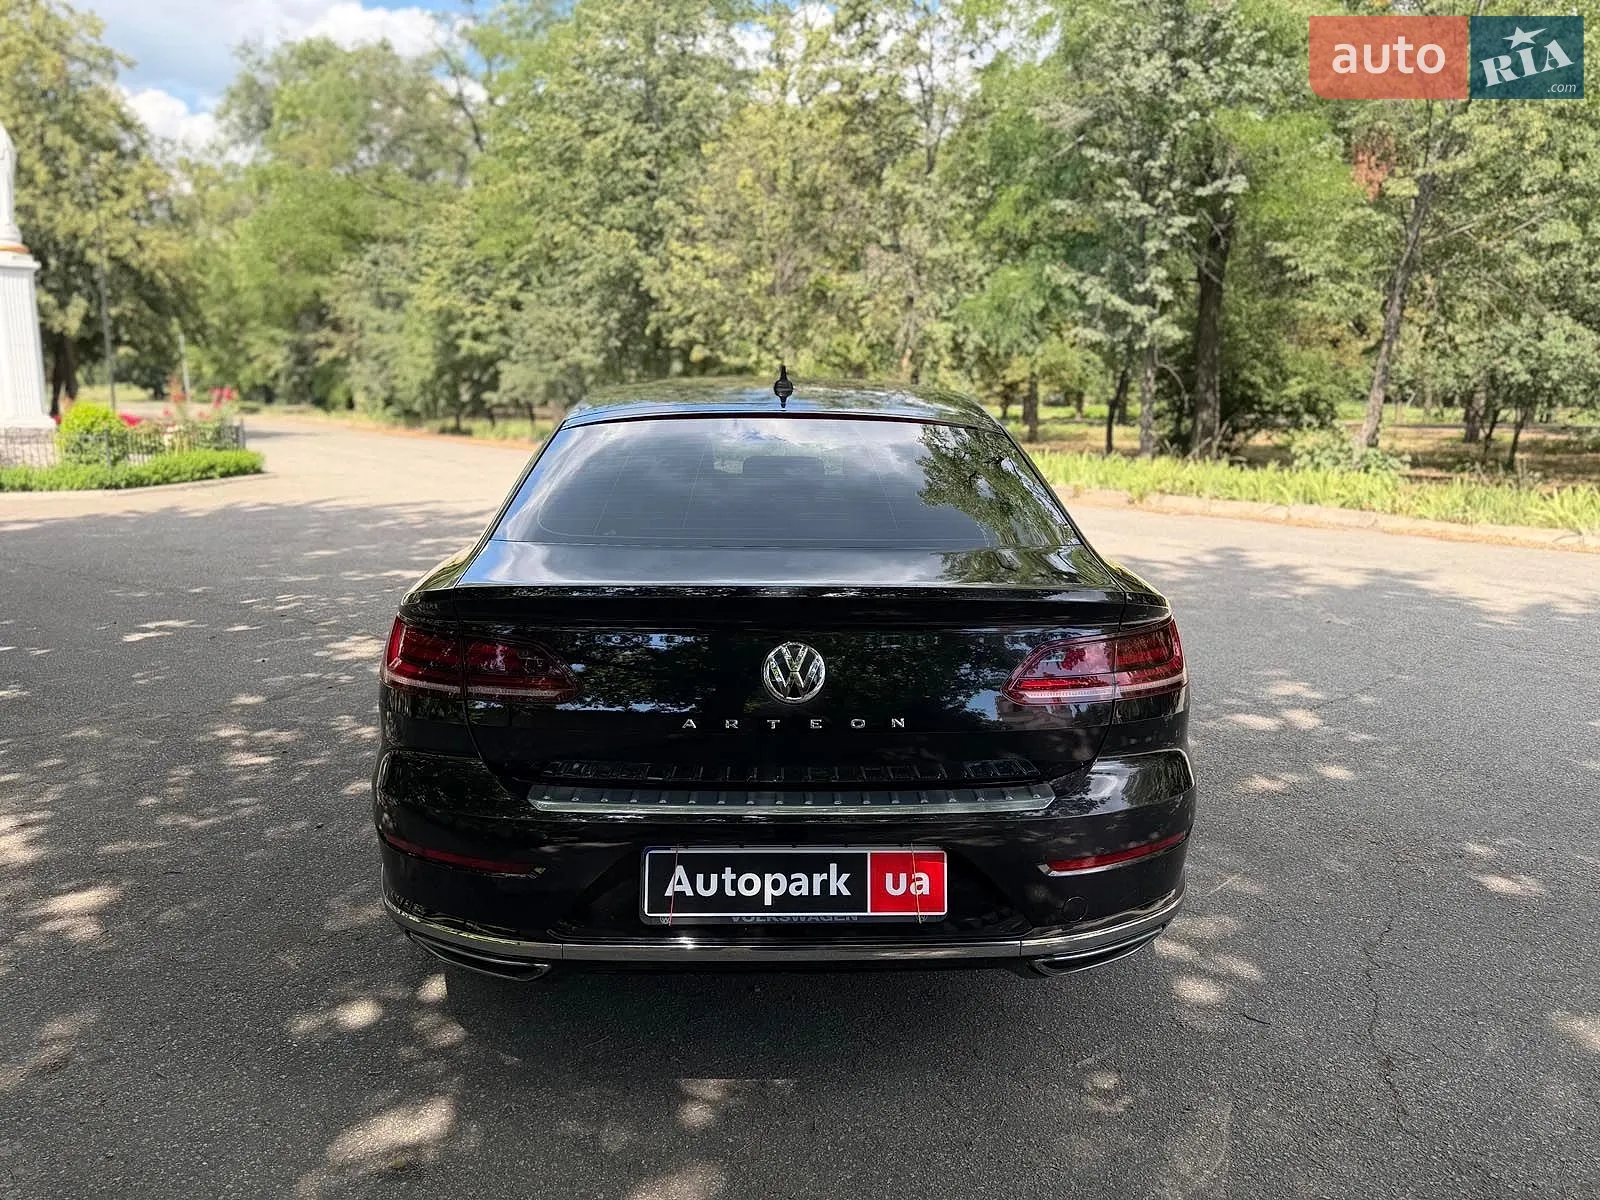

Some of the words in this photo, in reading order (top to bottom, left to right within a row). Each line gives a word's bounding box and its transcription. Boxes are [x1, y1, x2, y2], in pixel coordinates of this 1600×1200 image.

[682, 718, 905, 729] ARTEON
[664, 863, 851, 906] Autopark
[885, 871, 930, 895] ua
